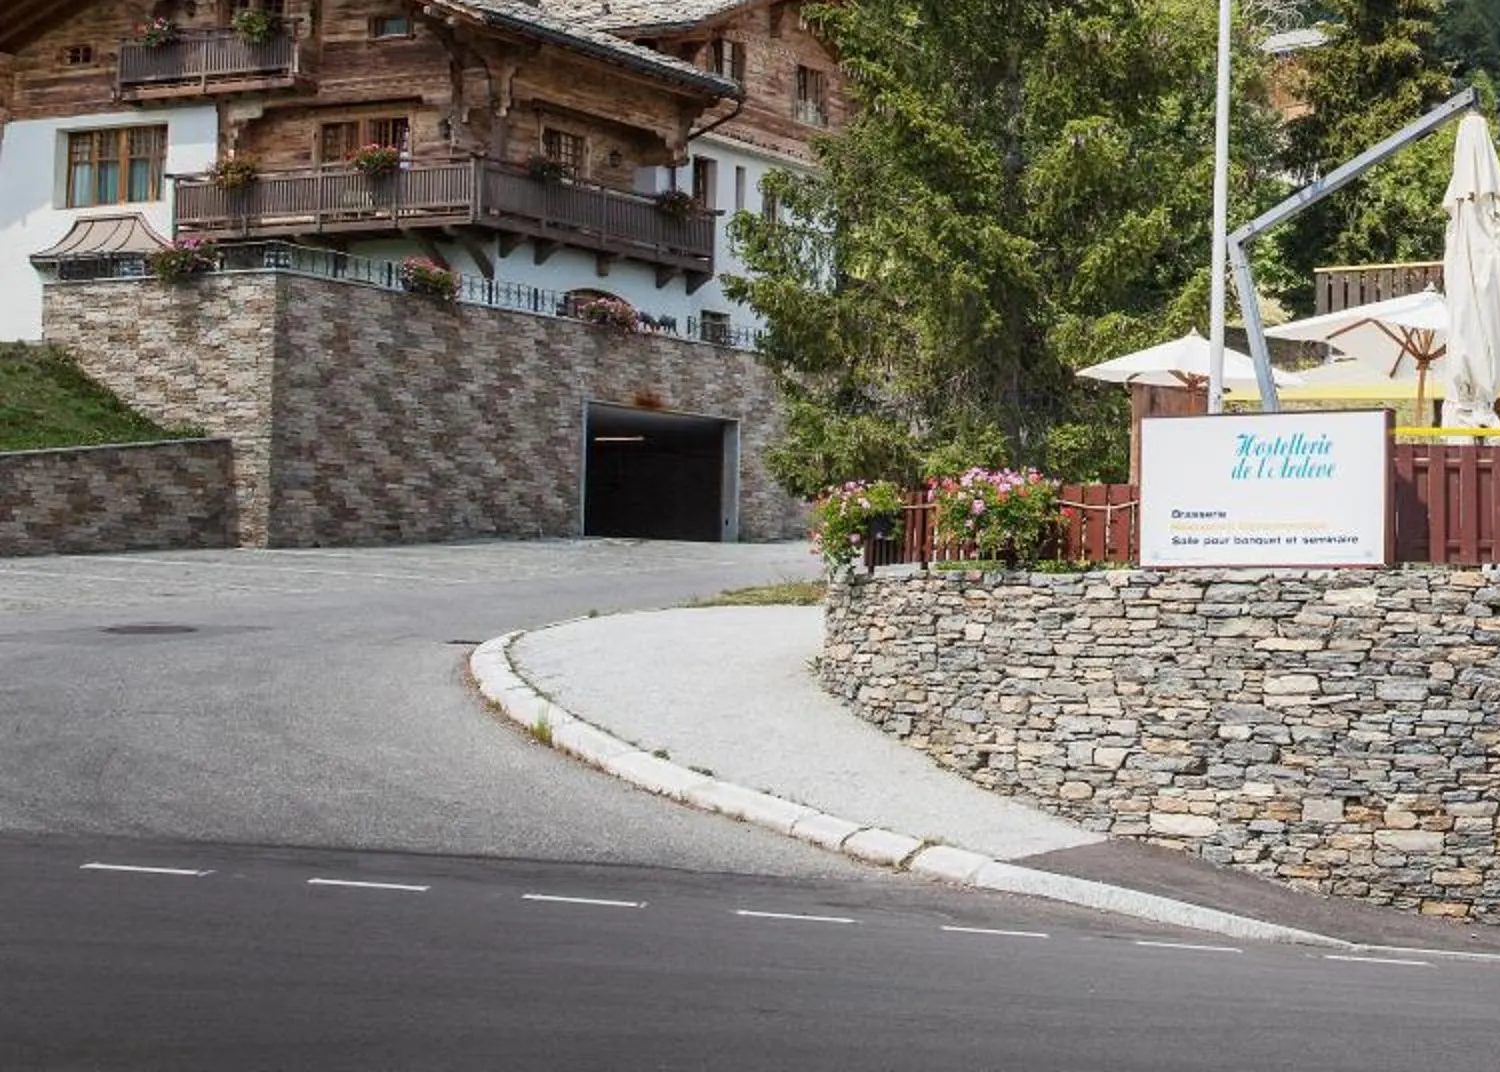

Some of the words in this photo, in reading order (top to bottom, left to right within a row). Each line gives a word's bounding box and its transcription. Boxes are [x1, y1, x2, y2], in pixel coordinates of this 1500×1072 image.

[1235, 431, 1333, 457] Hostellerie
[1231, 456, 1251, 480] de
[1171, 535, 1200, 546] Salle
[1203, 536, 1230, 548] pour
[1233, 534, 1281, 546] banquet
[1285, 535, 1297, 545] et
